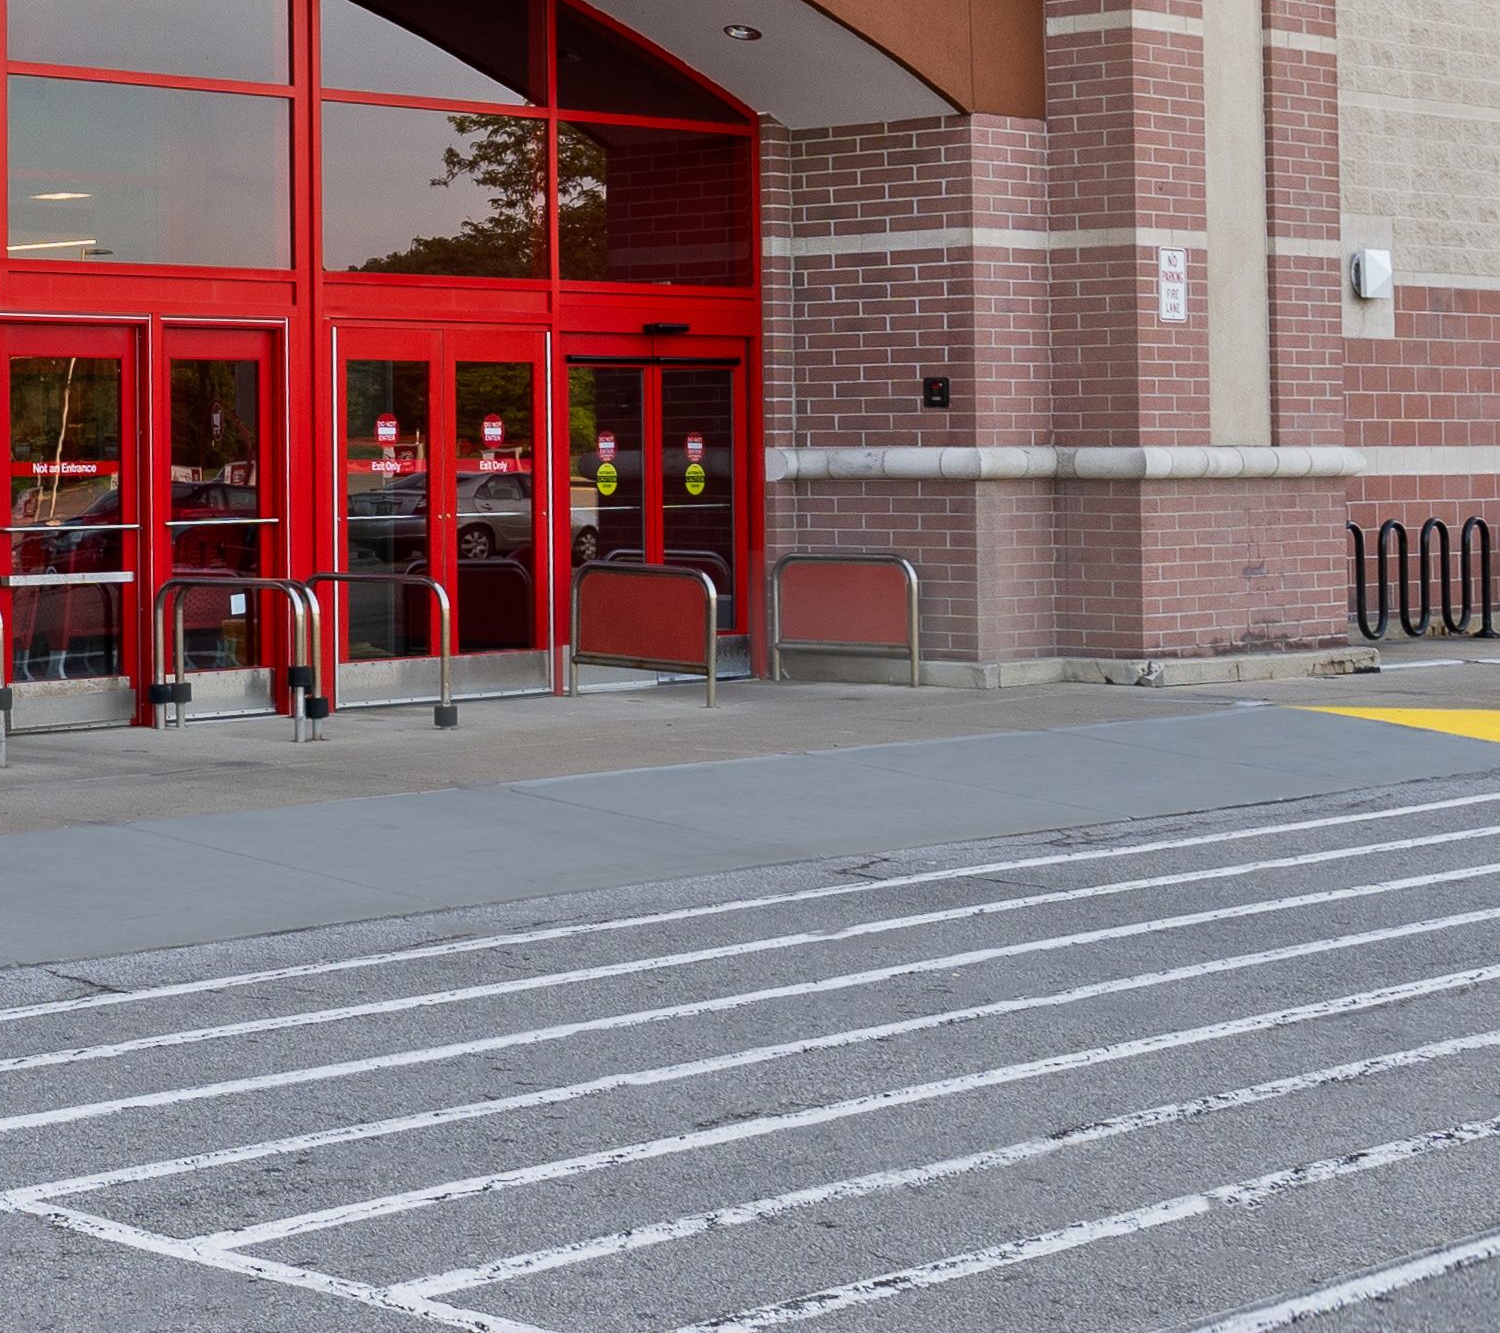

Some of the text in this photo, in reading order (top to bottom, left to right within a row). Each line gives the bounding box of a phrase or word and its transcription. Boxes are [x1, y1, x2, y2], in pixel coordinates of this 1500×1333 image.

[32, 462, 97, 473] Not an Entrance
[371, 460, 401, 472] Exit Only
[479, 461, 508, 472] Exit Only
